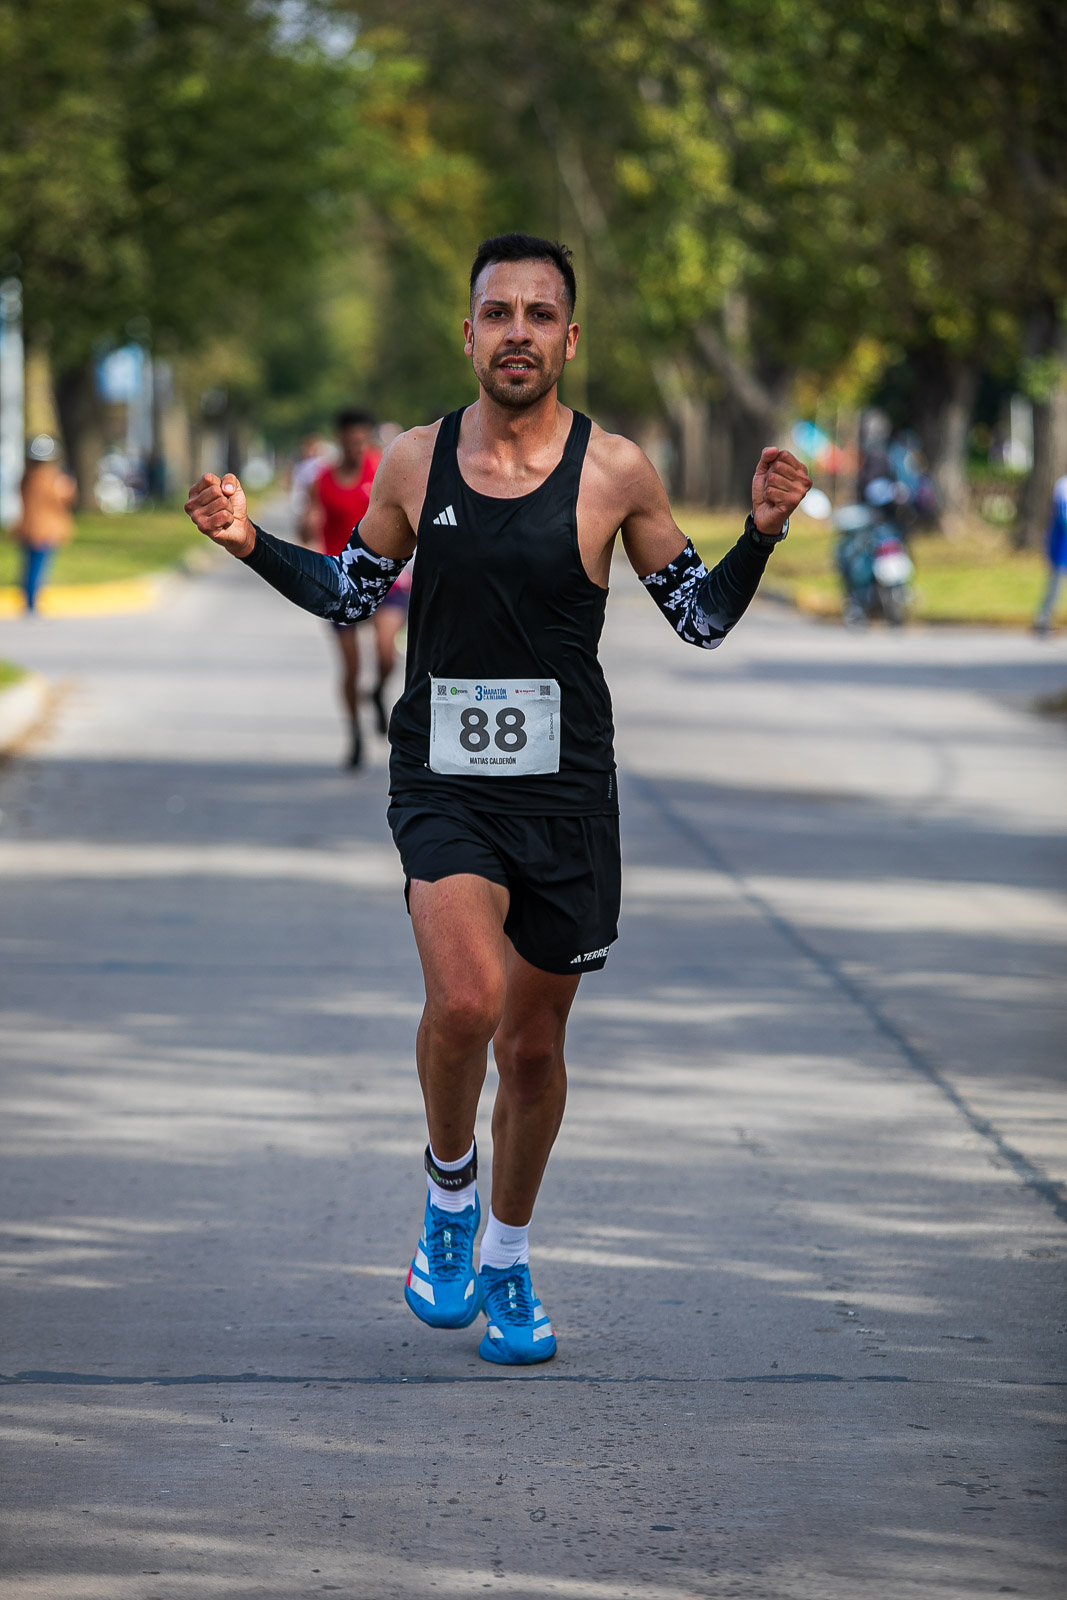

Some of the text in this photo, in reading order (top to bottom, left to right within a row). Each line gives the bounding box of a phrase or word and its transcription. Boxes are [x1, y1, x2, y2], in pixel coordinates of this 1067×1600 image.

[475, 685, 483, 701] 3
[459, 707, 528, 753] 88
[469, 756, 517, 765] MATIAS CALDERÓN
